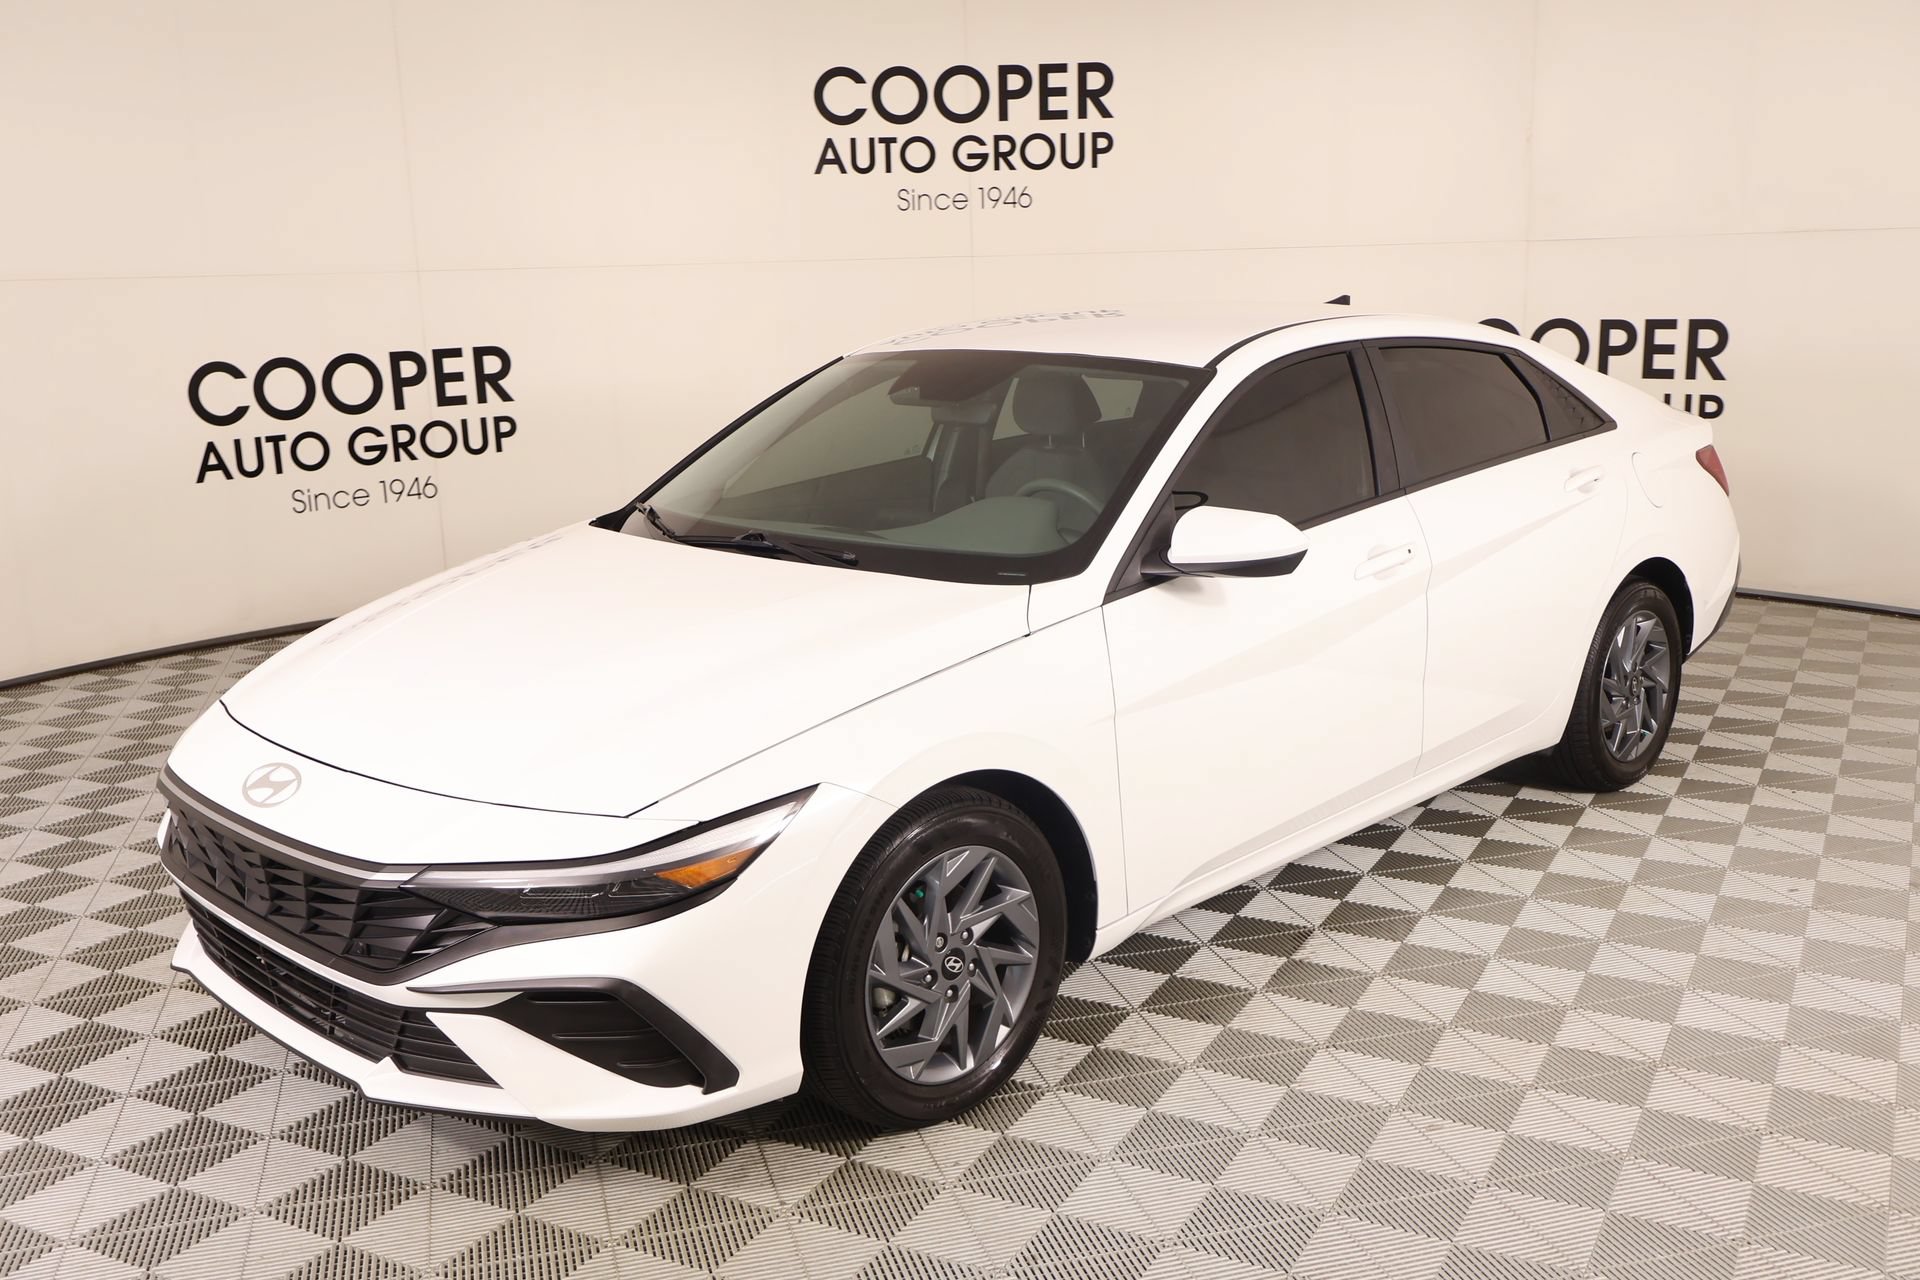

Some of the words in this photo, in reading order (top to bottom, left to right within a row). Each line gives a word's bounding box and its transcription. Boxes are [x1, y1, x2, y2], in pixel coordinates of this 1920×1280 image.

[813, 62, 1115, 126] COOPER
[814, 136, 937, 175] AUTO
[952, 131, 1115, 173] GROUP
[896, 188, 969, 212] Since
[977, 185, 1033, 210] 1946
[1478, 317, 1729, 381] OPER
[187, 346, 516, 427] COOPER
[195, 430, 331, 485] AUTO
[347, 415, 518, 466] GROUP
[291, 488, 371, 514] Since
[379, 475, 439, 504] 1946
